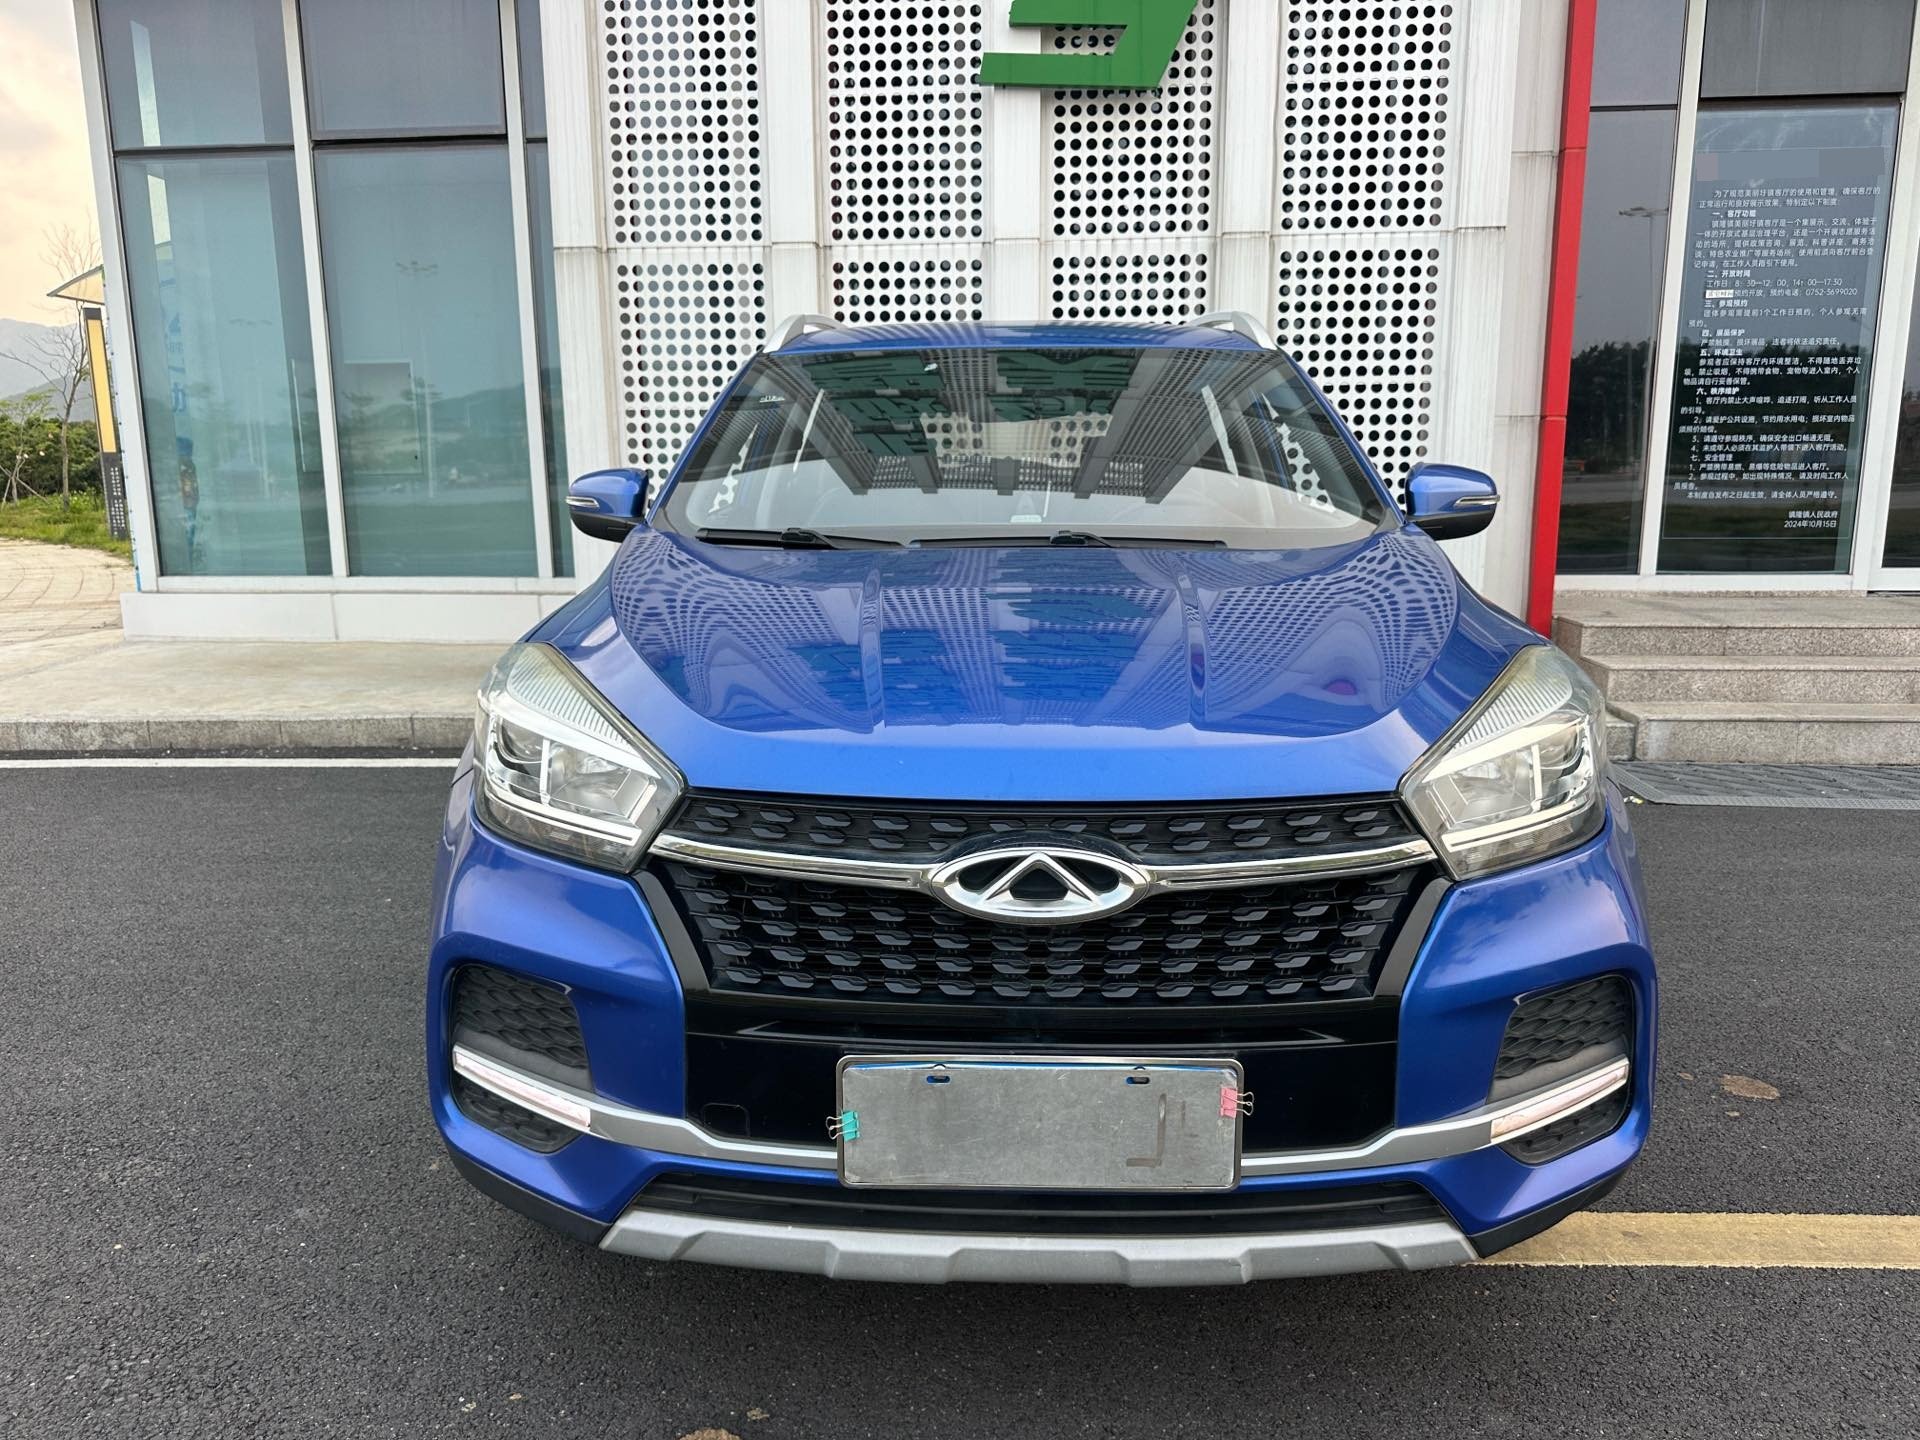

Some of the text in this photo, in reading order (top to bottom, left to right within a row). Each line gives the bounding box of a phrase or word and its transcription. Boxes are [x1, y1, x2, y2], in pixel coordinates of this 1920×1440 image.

[1708, 270, 1750, 278] 二、开放时间
[1784, 520, 1837, 528] 2024年10月15日
